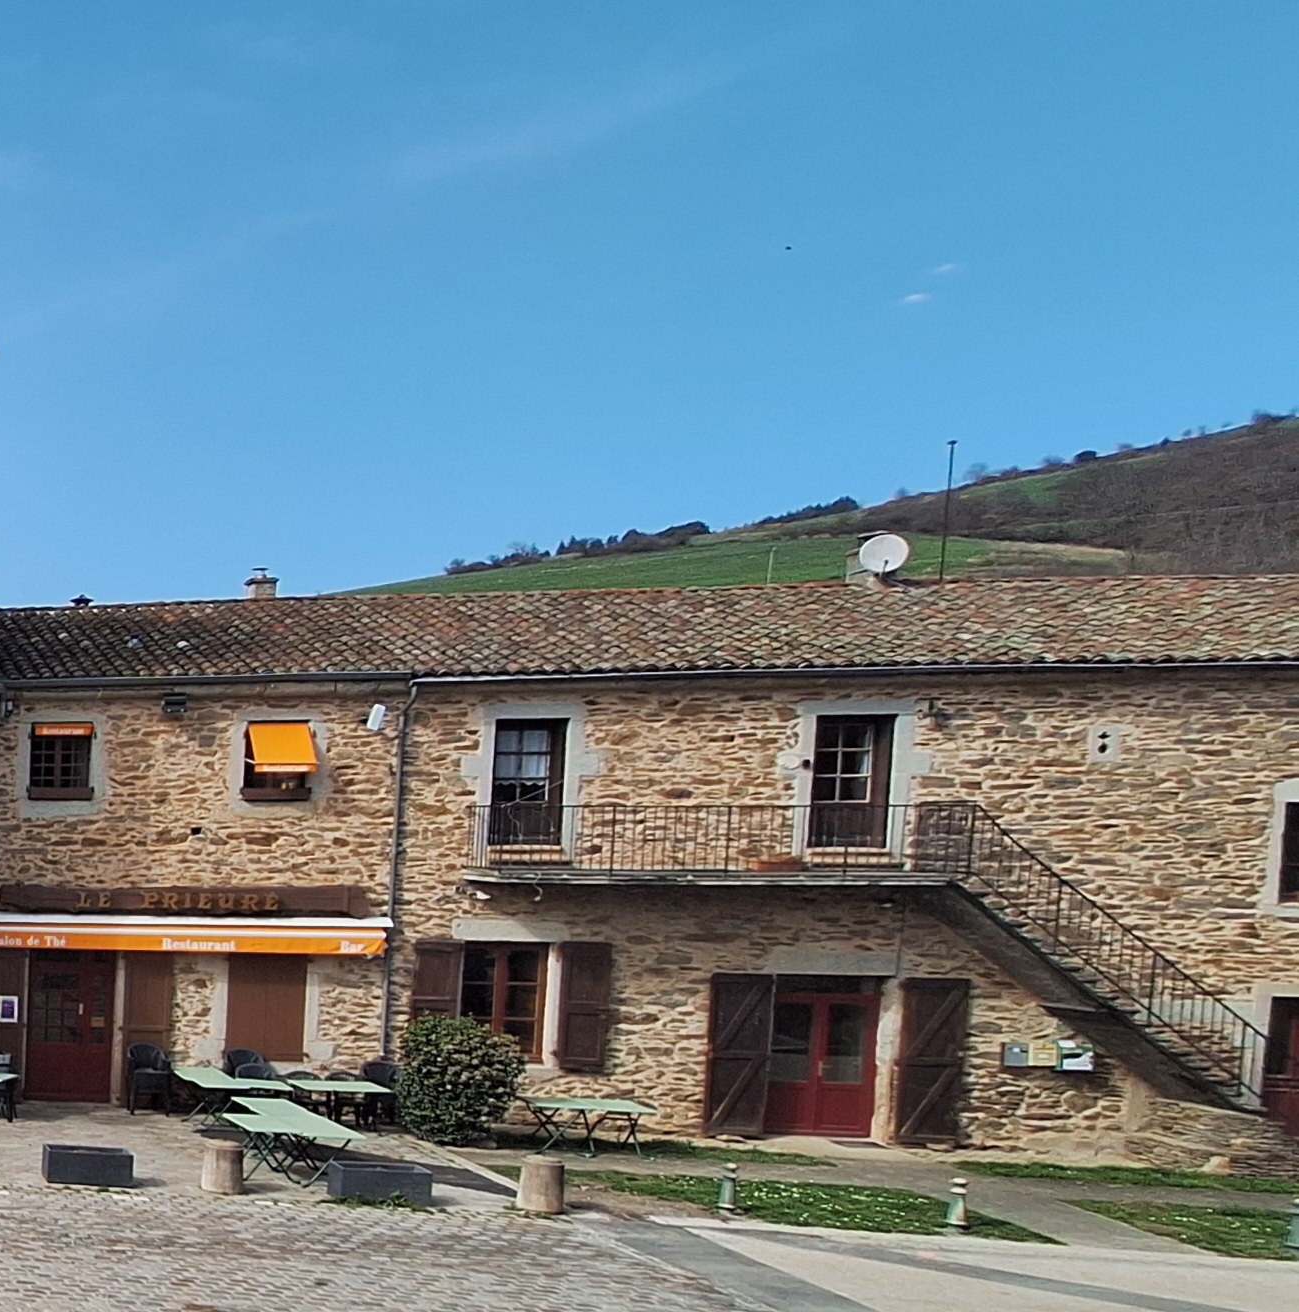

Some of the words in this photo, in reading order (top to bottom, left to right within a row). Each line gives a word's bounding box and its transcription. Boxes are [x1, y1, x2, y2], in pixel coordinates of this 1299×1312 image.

[76, 891, 111, 908] LE
[27, 935, 40, 946] de
[44, 936, 66, 947] Thé
[162, 937, 237, 951] Restaurant
[340, 940, 365, 953] Bar
